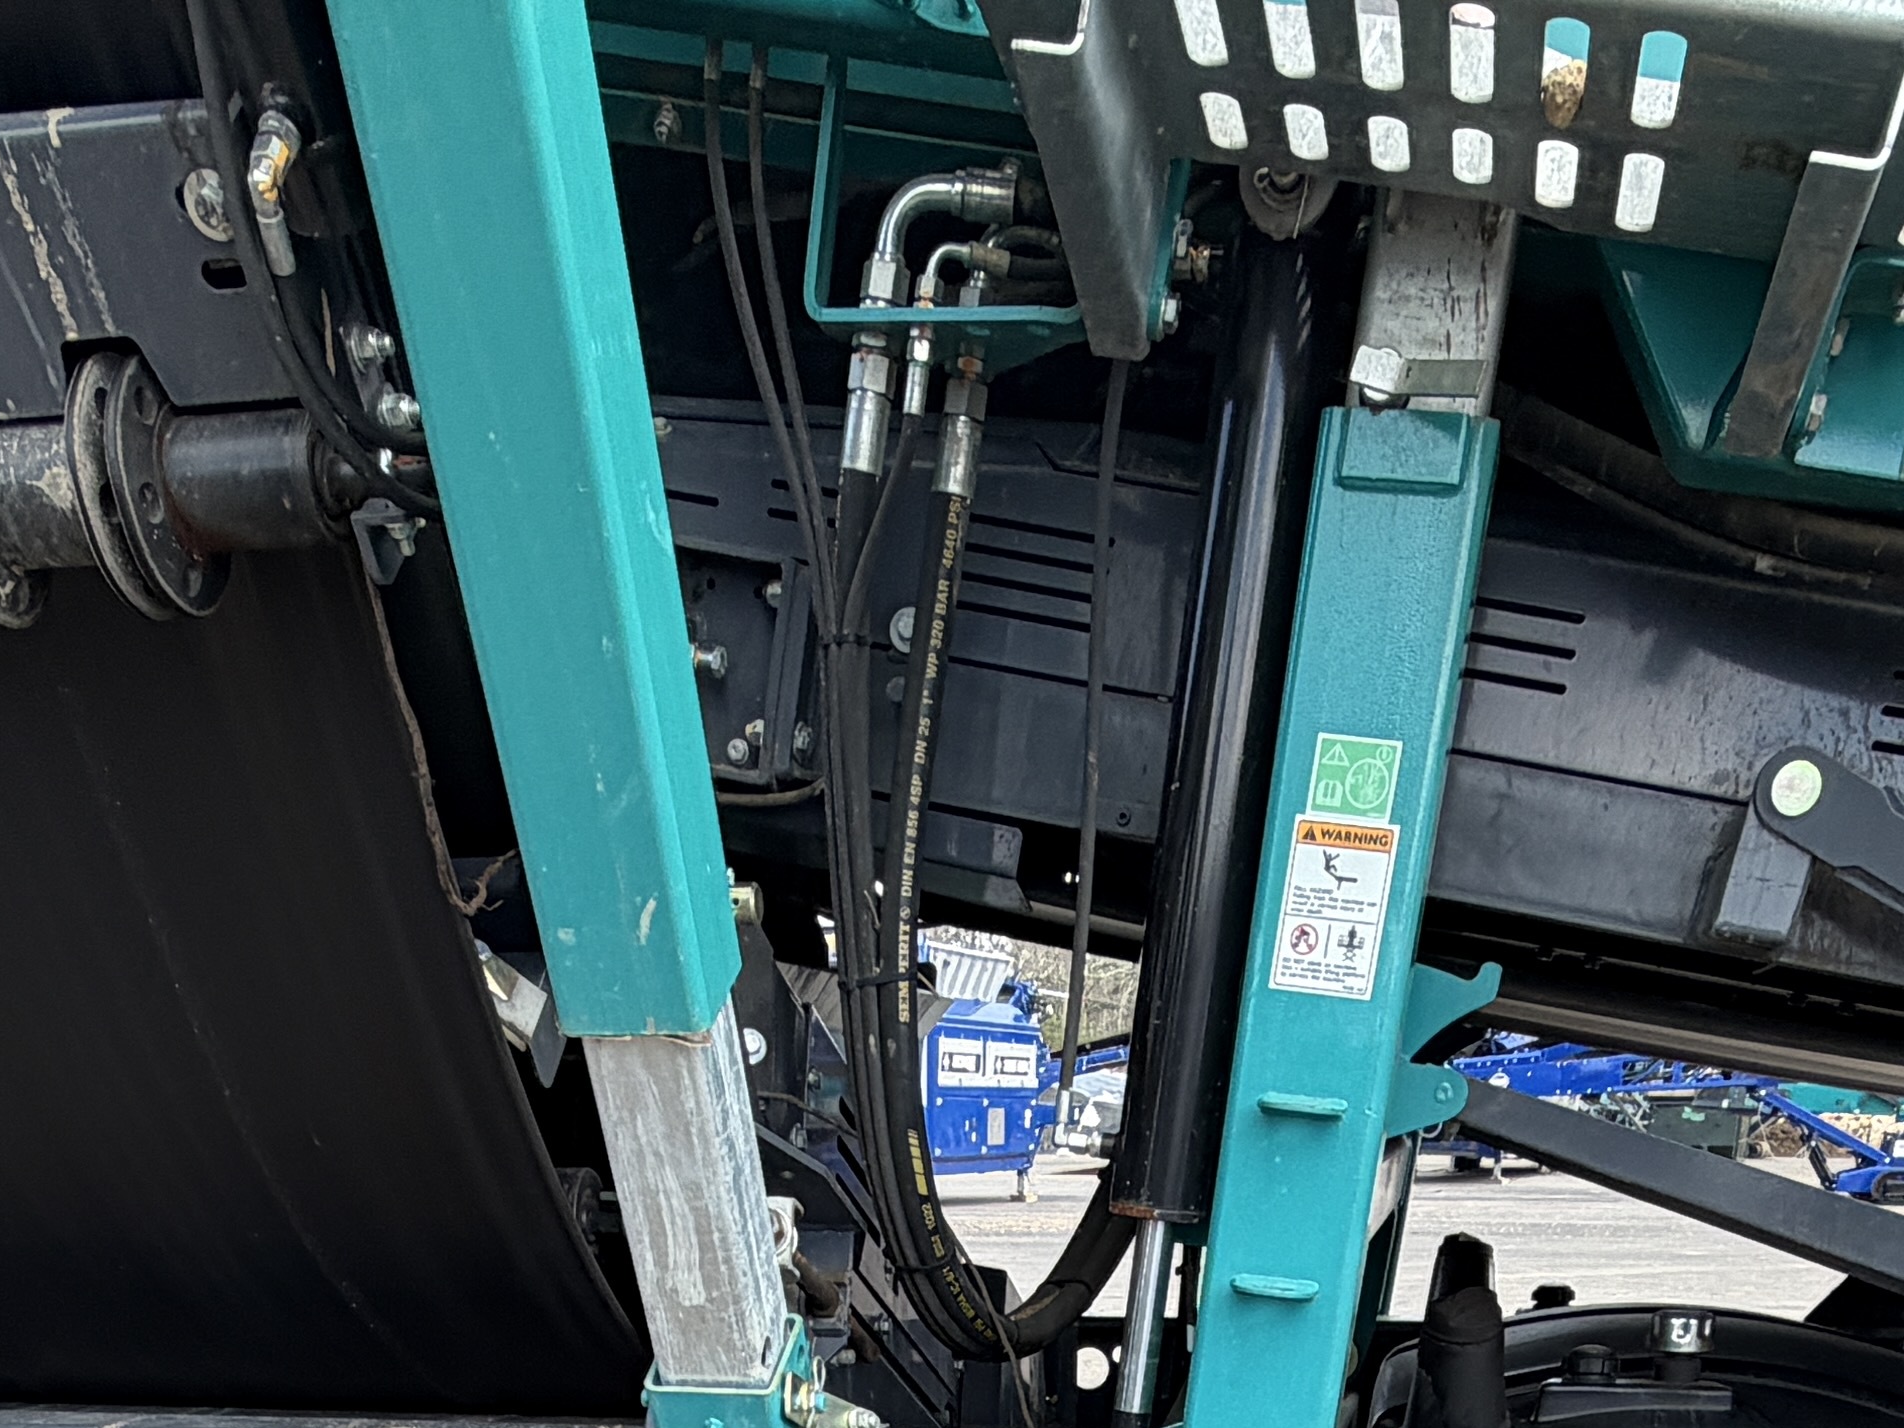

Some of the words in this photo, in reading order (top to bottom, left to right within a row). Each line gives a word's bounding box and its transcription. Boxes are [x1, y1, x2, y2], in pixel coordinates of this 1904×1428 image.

[947, 496, 962, 524] PSI
[942, 529, 958, 569] 4640
[934, 579, 951, 615] BAR
[930, 619, 945, 649] 320
[925, 652, 939, 679] WP
[919, 716, 931, 736] 25
[914, 740, 928, 764] DN
[909, 774, 923, 805] 4SP
[906, 810, 919, 838] 856
[1321, 826, 1389, 847] WARNING
[901, 869, 914, 897] DIN
